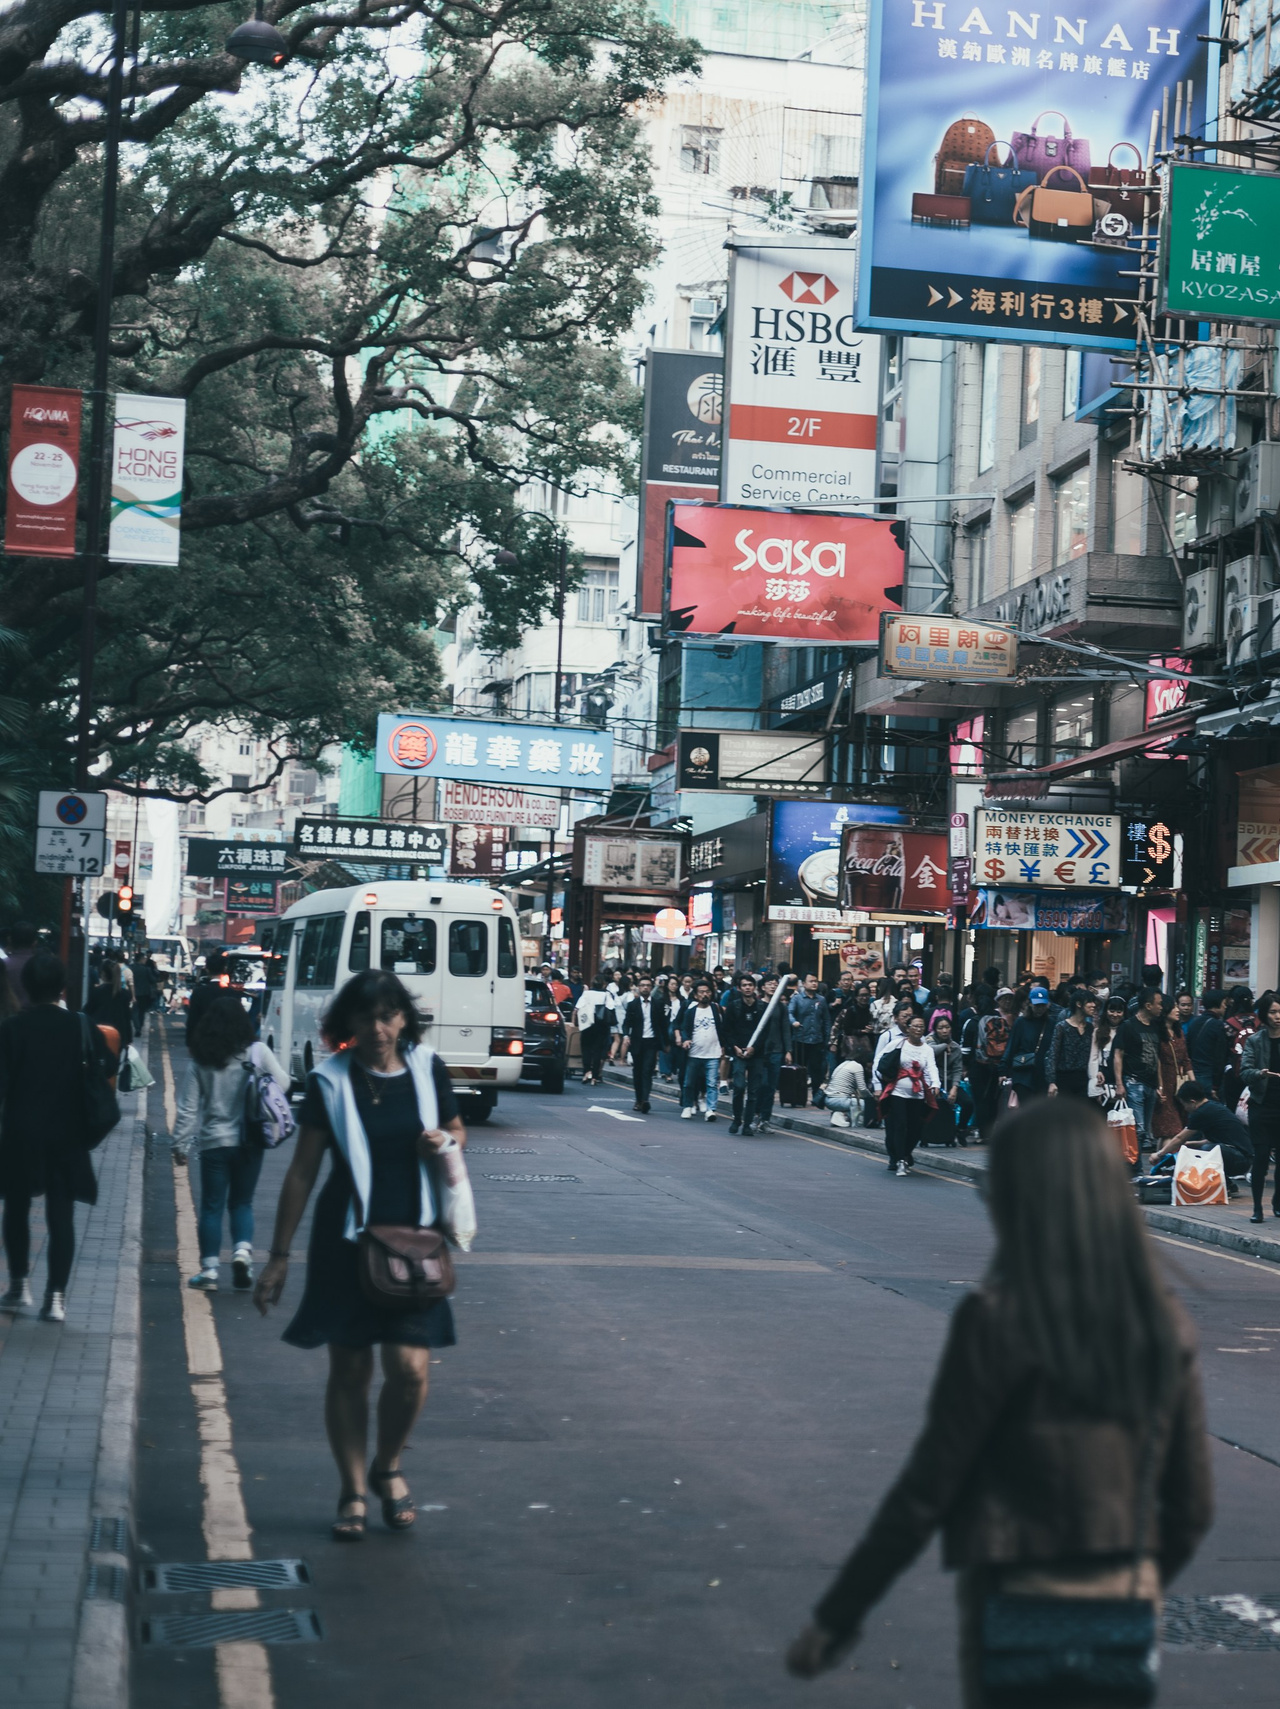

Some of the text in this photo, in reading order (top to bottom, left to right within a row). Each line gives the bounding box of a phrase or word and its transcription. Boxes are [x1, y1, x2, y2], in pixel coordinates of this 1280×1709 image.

[911, 0, 1180, 57] HANNAH
[938, 37, 1151, 80] 漢納歐洲名牌旗艦店
[1190, 248, 1261, 277] 居酒屋
[971, 288, 1103, 324] 海利行3樓
[750, 306, 864, 348] HSBC
[23, 406, 70, 422] HONMA
[787, 416, 822, 438] 2/F
[671, 430, 704, 446] Thai
[34, 452, 45, 461] 22
[52, 453, 63, 462] 25
[118, 447, 178, 465] HONG
[117, 461, 177, 479] KONG
[662, 464, 719, 476] RESTAURANT
[751, 464, 852, 486] Commercial
[741, 483, 801, 502] Service
[764, 577, 811, 603] 莎莎
[736, 606, 772, 623] making
[773, 606, 793, 623] life
[898, 624, 979, 650] 阿里朗
[397, 730, 430, 763] 藥
[444, 731, 605, 777] 龍華藥妝
[444, 782, 526, 809] HENDERSON
[443, 808, 484, 822] ROSEWOOD
[486, 810, 526, 824] FURNITURE
[533, 814, 557, 826] CHEST
[984, 811, 1113, 828] MONEY EXCHANGE
[47, 837, 68, 847] 上午
[51, 829, 92, 848] am 7
[984, 825, 1060, 842] 兩替找換
[218, 847, 287, 866] 六福珠寶
[984, 841, 1060, 858] 特快匯款
[38, 853, 99, 873] midnight 12
[910, 854, 948, 889] 金
